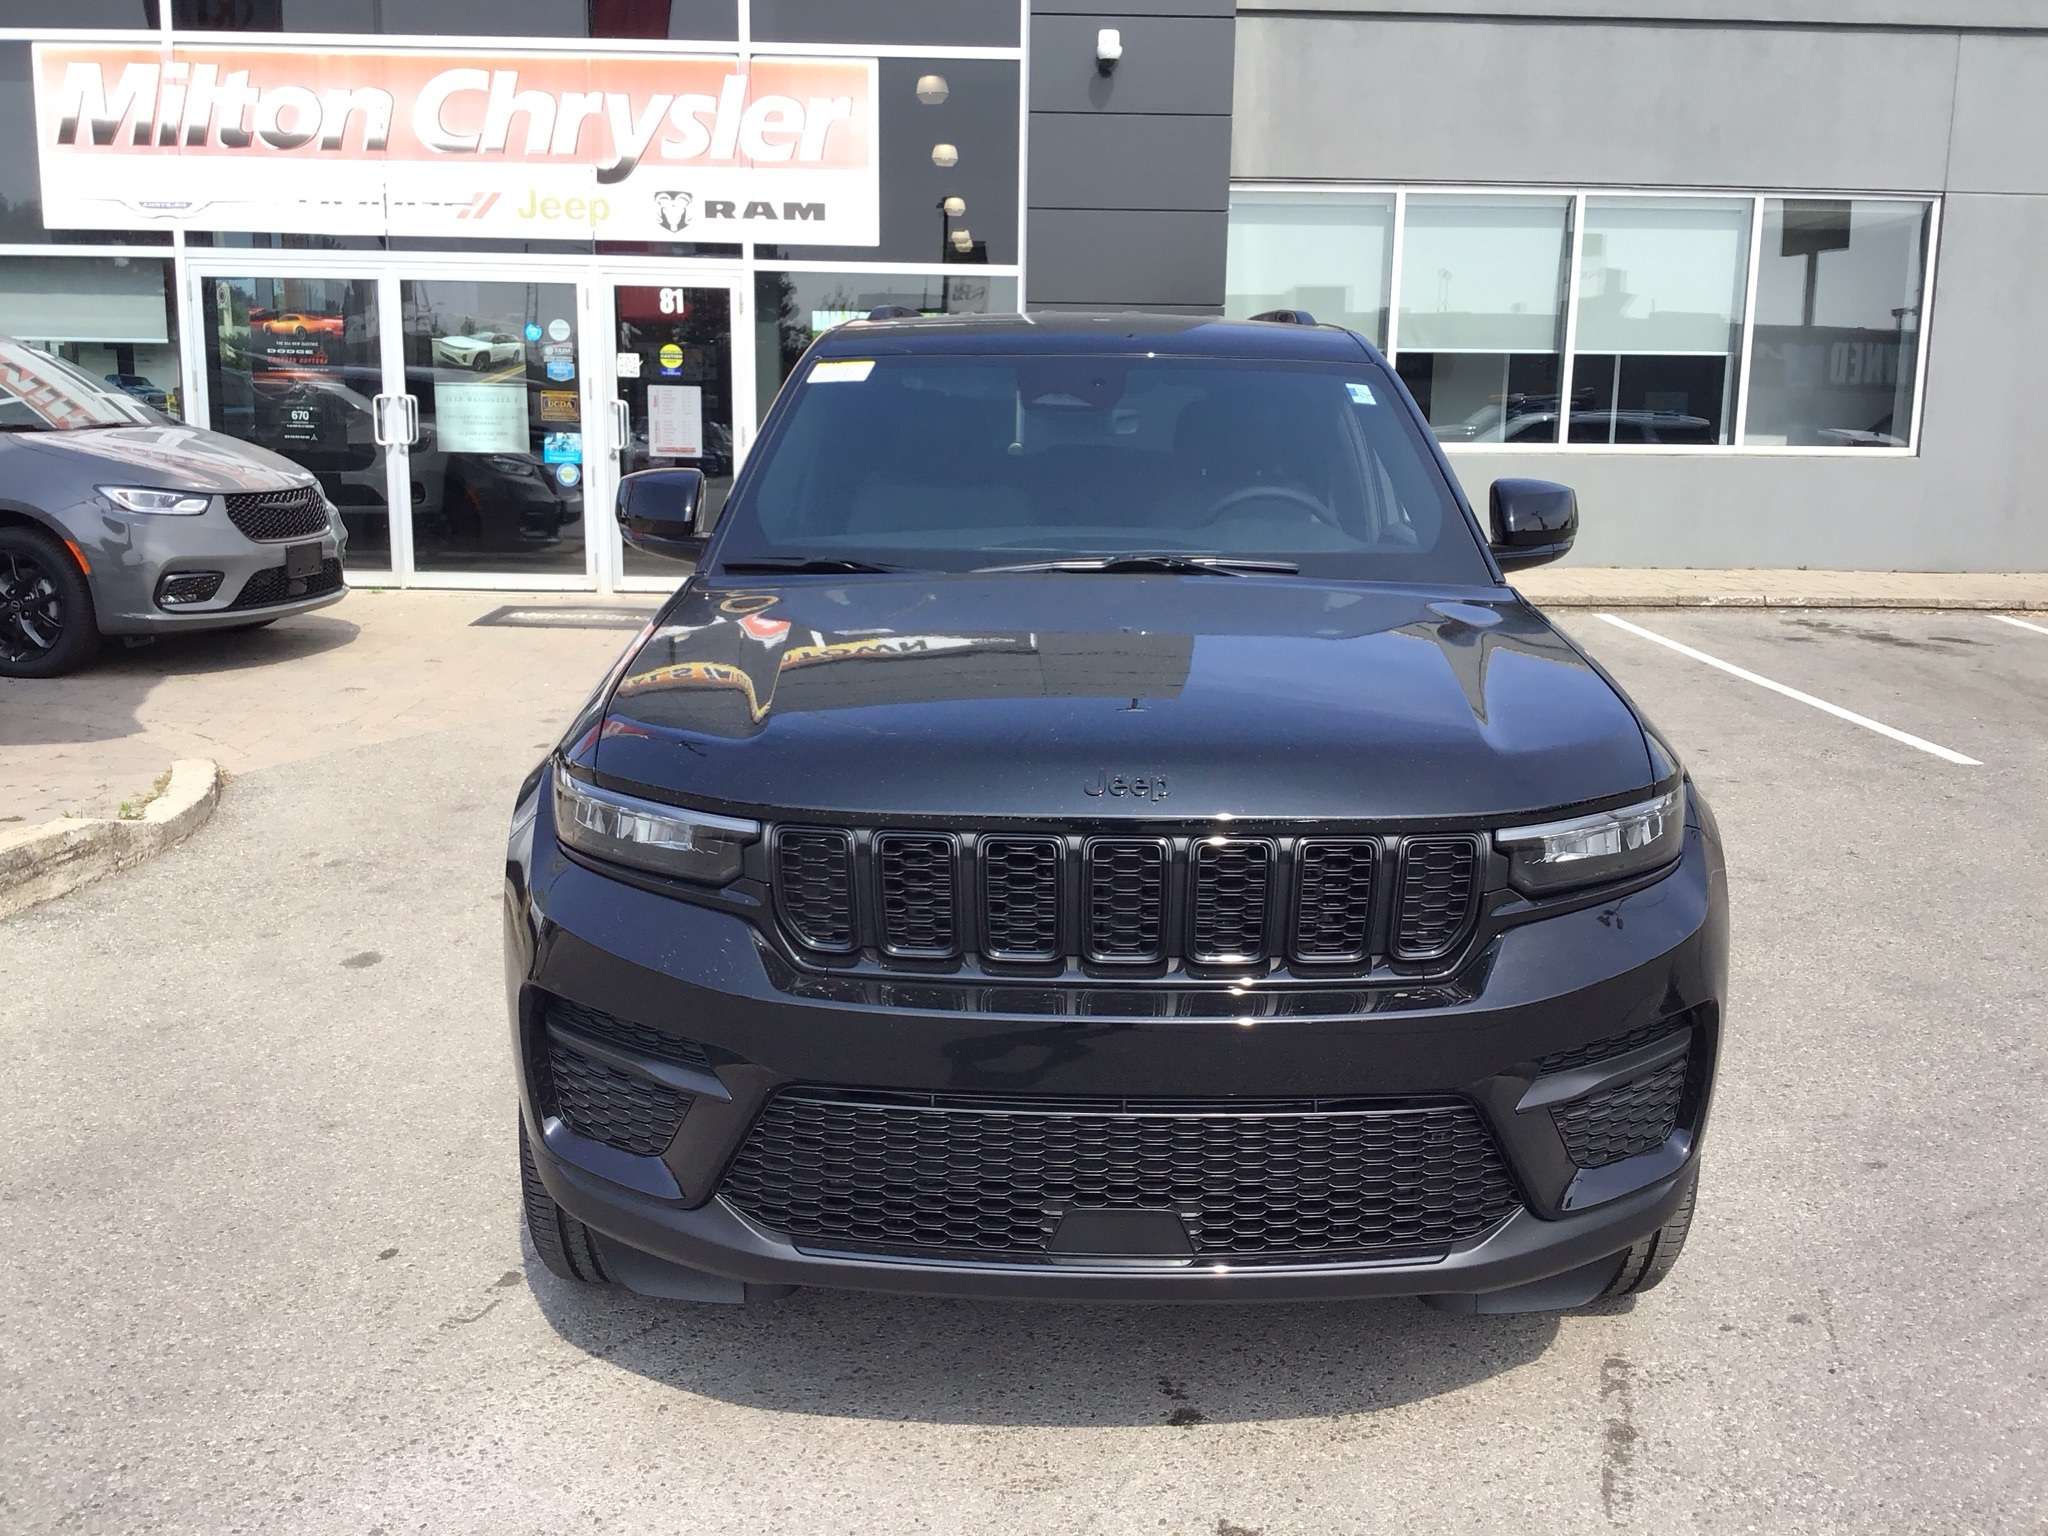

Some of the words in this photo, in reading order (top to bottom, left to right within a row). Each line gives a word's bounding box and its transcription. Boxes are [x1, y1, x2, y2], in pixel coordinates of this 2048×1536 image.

[57, 62, 394, 152] Milton
[411, 67, 854, 184] Chrysler
[518, 190, 610, 227] Jeep
[705, 200, 825, 221] RAM
[660, 288, 684, 314] 81
[291, 410, 310, 421] 670
[1084, 772, 1170, 802] Jeep
